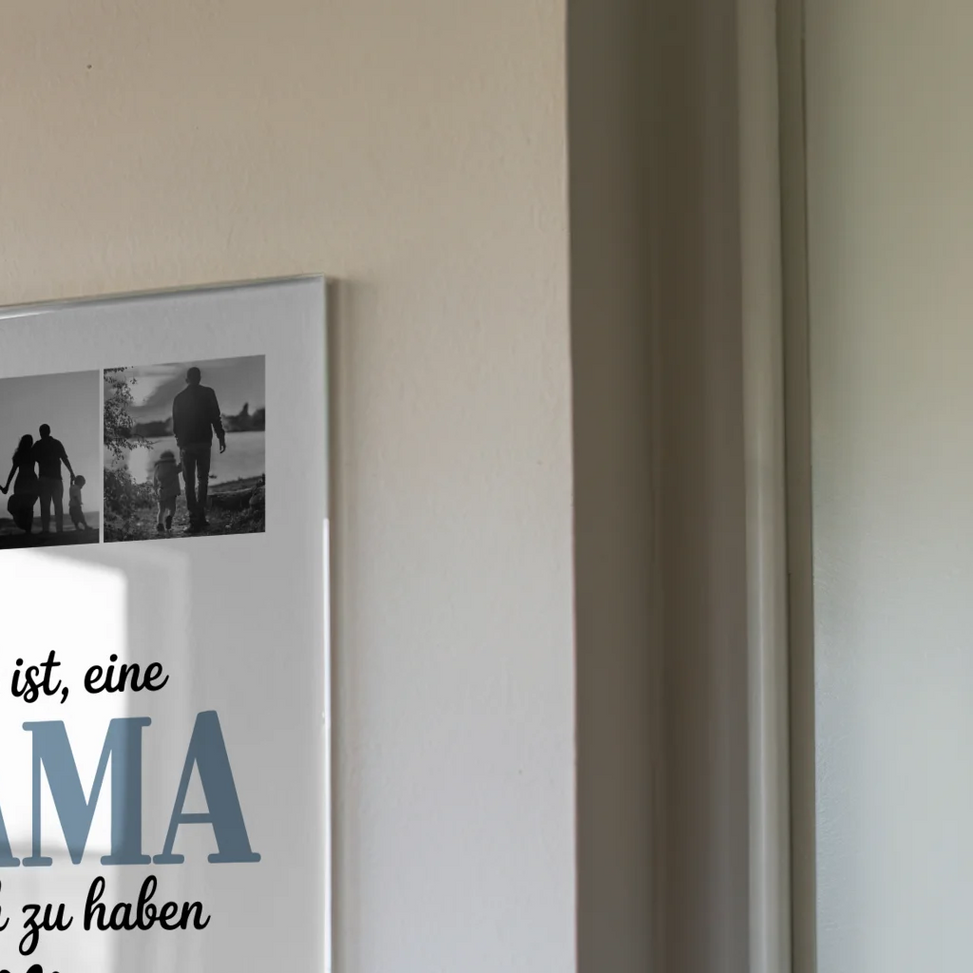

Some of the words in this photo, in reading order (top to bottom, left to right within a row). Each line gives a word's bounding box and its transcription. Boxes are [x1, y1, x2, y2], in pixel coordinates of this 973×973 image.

[11, 649, 69, 704] ist,
[84, 653, 170, 694] eine
[18, 903, 74, 956] zu
[83, 874, 212, 931] haben
